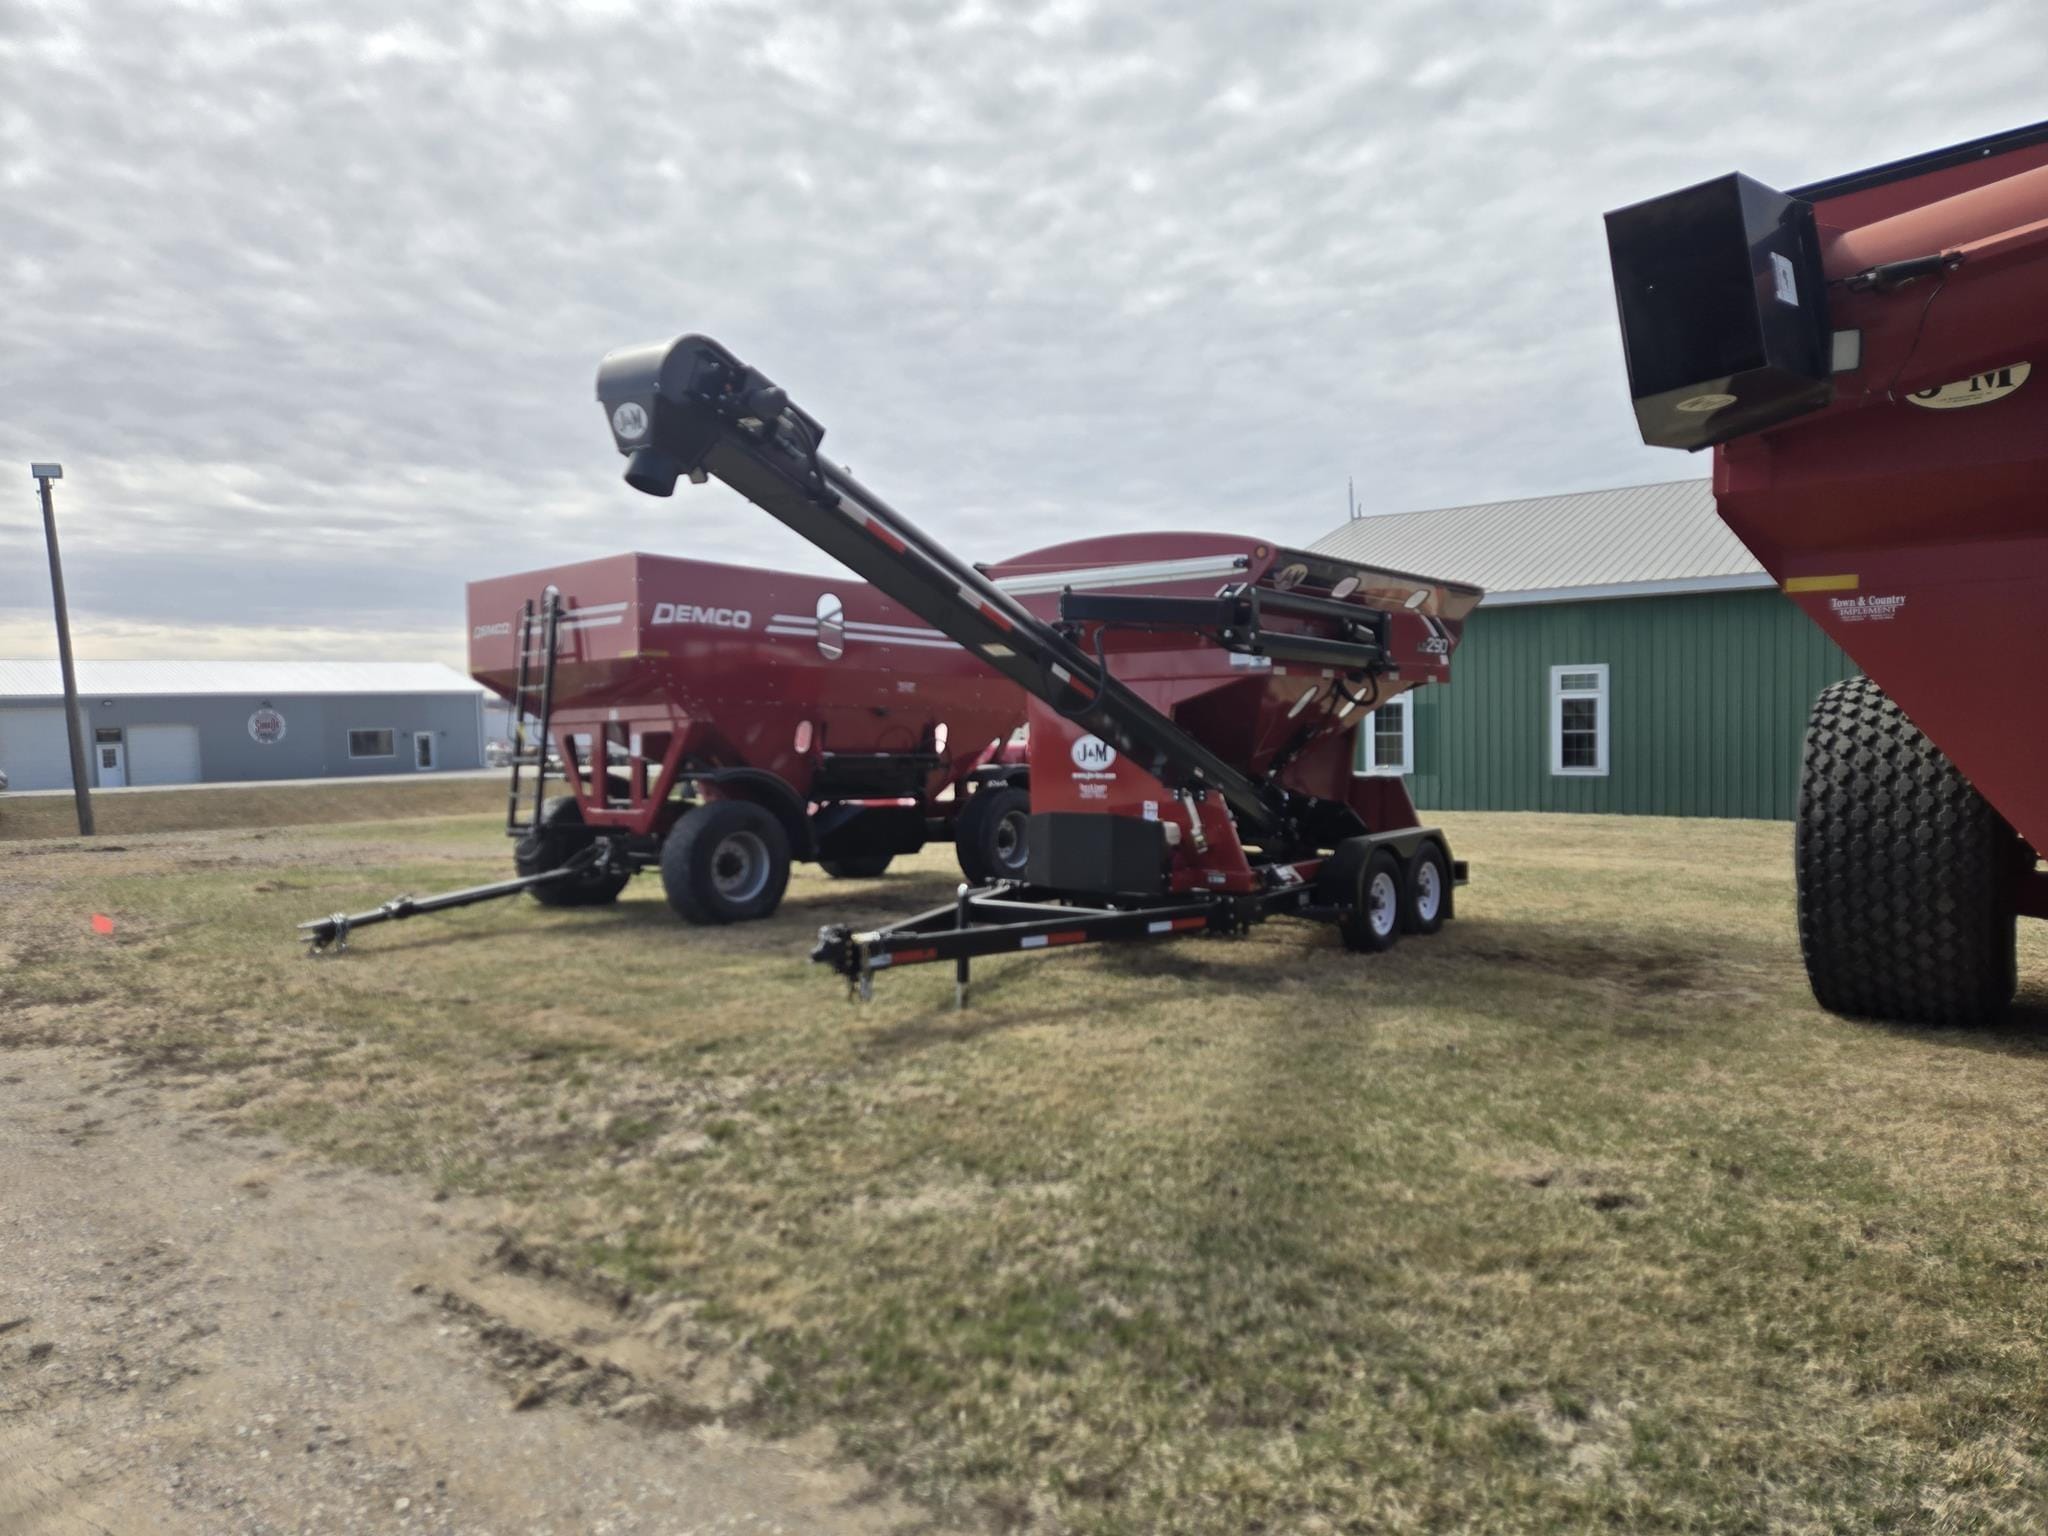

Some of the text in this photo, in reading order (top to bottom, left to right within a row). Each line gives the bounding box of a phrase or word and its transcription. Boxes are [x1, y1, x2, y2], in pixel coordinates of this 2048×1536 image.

[1831, 595, 1906, 608] Town & Country
[651, 603, 752, 630] DEMCO
[1840, 606, 1896, 616] IMPLEMENT
[1078, 743, 1108, 762] J&M
